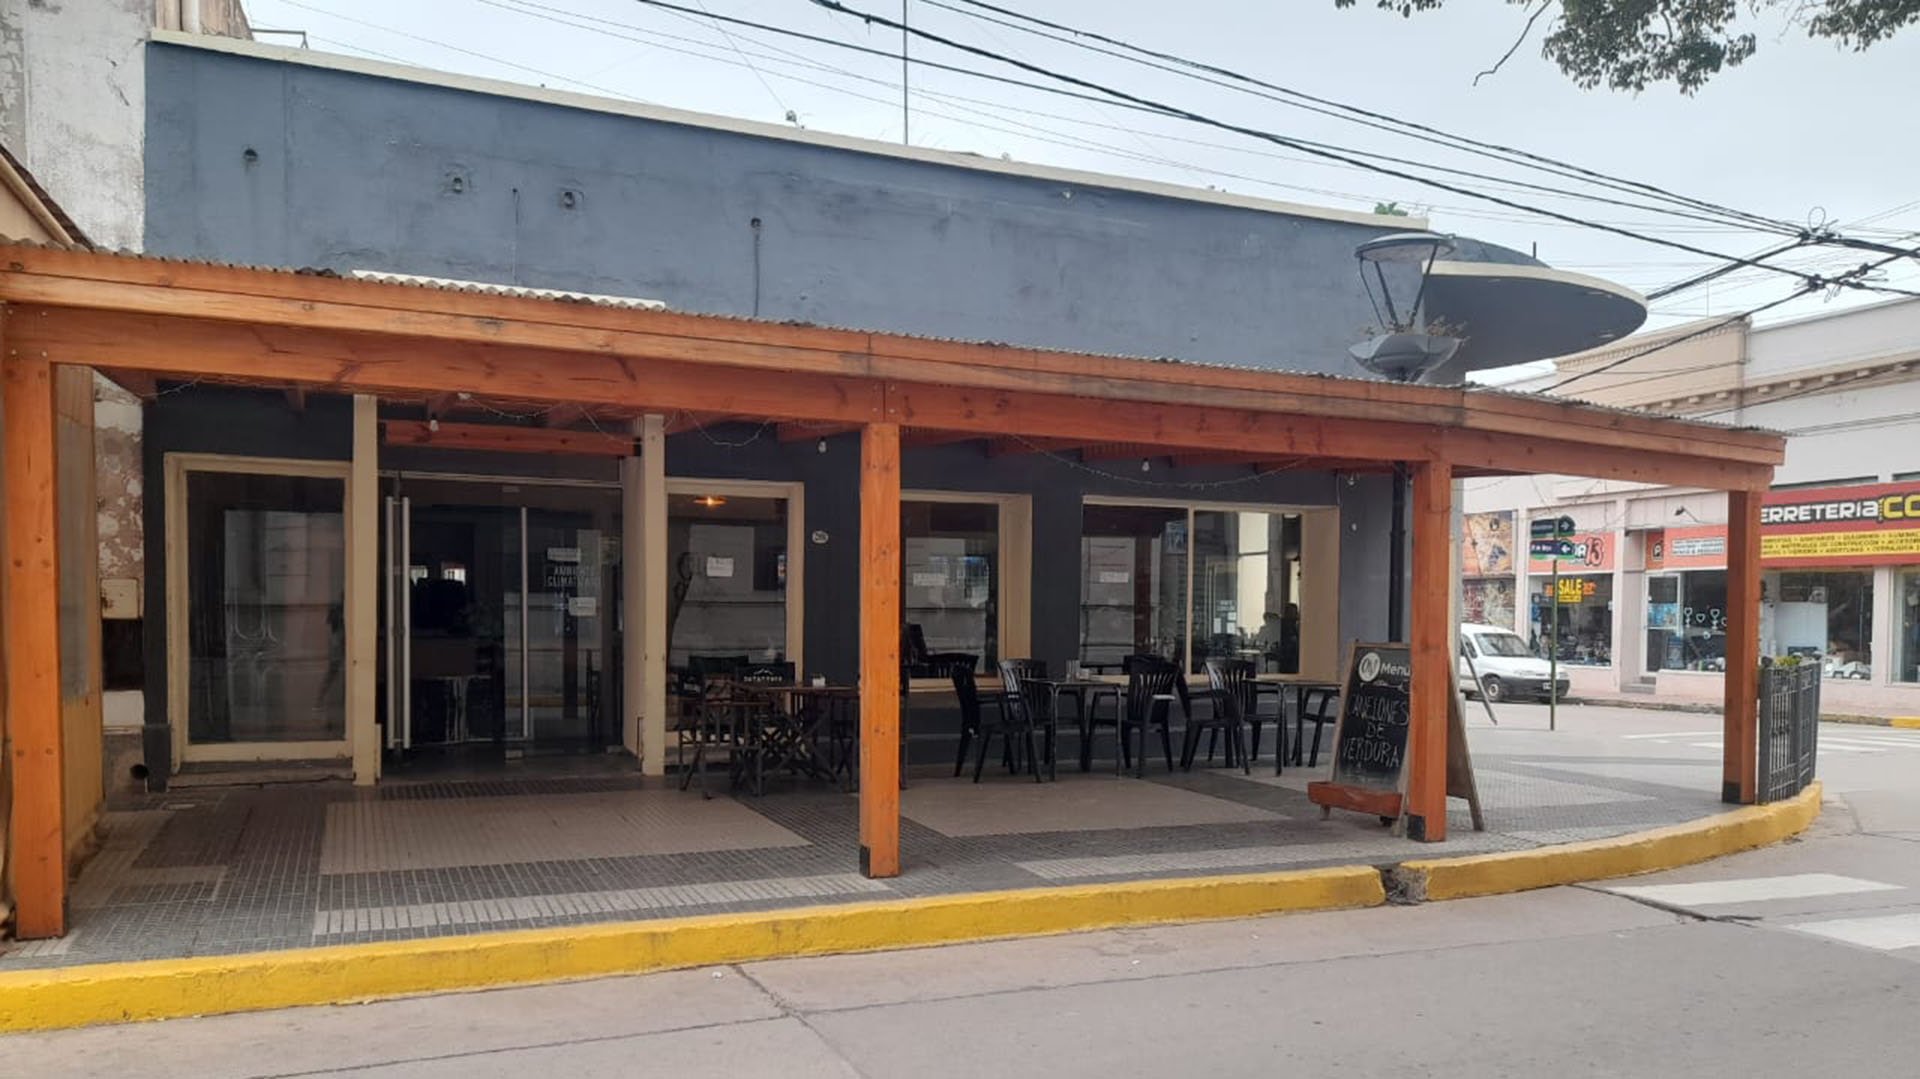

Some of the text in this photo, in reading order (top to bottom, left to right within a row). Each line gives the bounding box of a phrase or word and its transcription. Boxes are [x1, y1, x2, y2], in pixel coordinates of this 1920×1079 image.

[1558, 579, 1582, 594] SALE
[1365, 722, 1385, 739] DE
[1343, 737, 1399, 768] VERDURA
